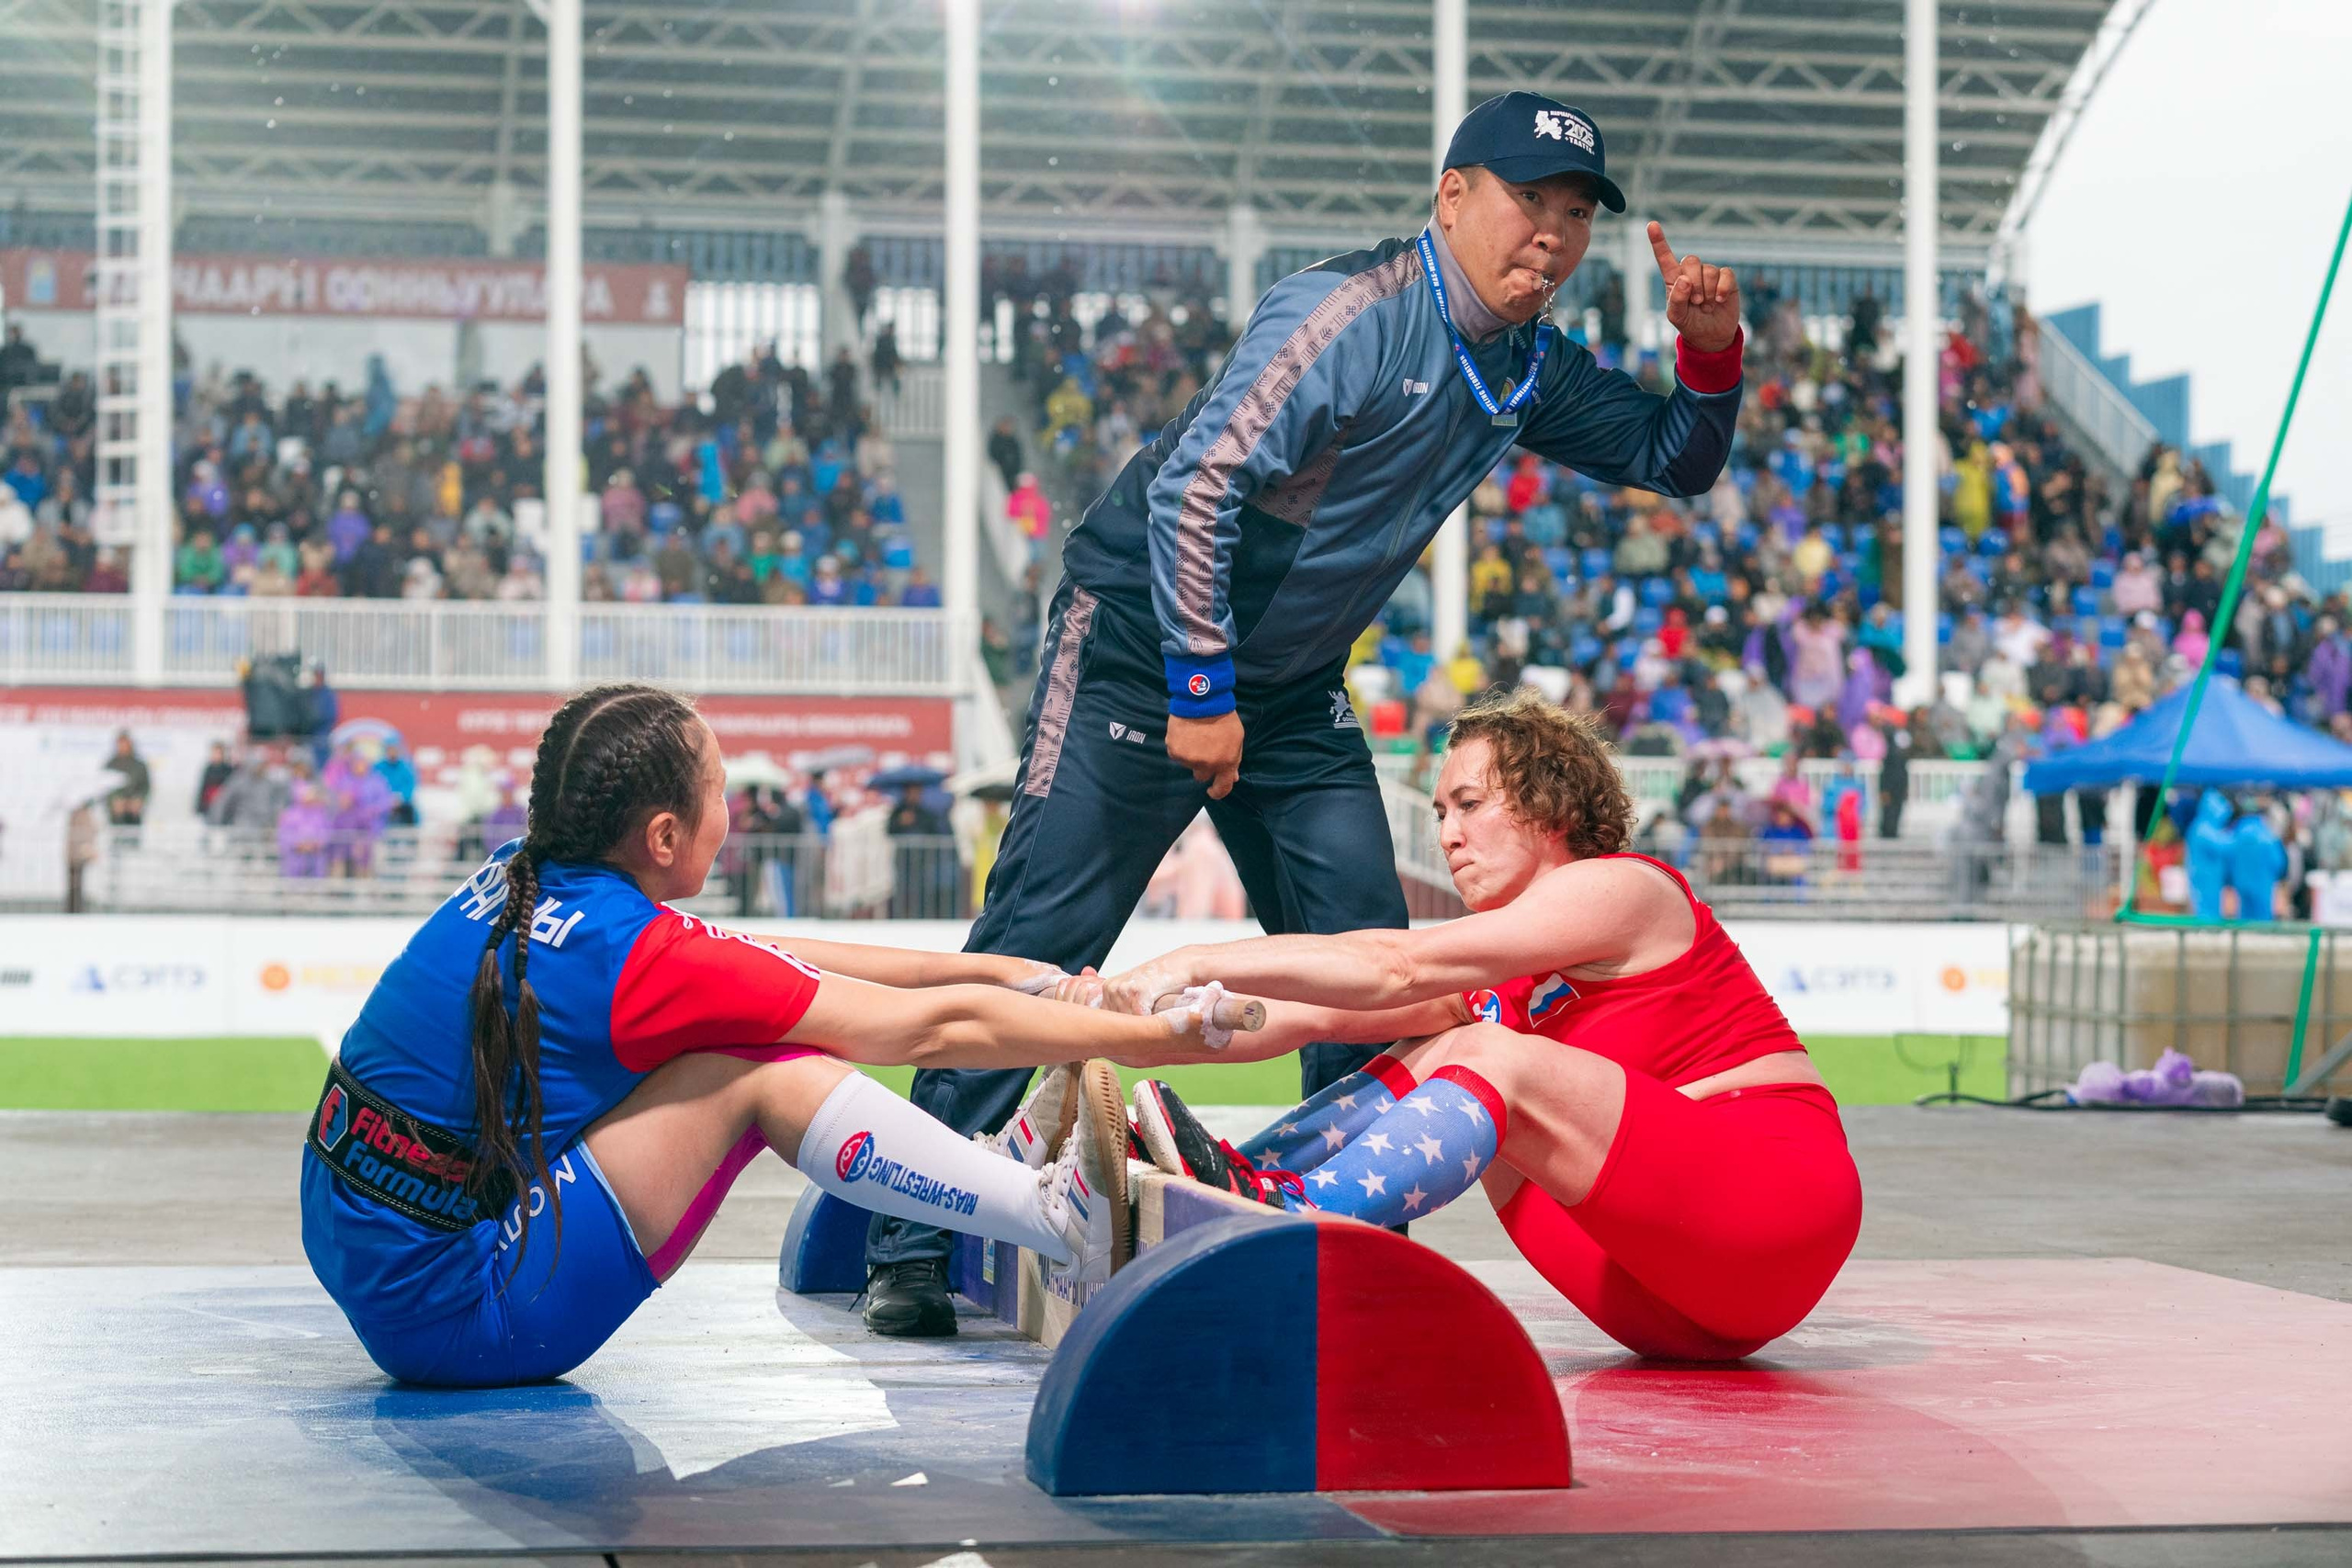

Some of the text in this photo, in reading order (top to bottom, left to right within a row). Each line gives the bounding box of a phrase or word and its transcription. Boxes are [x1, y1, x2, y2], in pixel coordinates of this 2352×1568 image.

[1459, 355, 1482, 390] FEDERATION
[1125, 729, 1147, 745] IRON
[344, 1140, 478, 1220] Formula
[868, 1156, 979, 1215] MAS-WRESTLING
